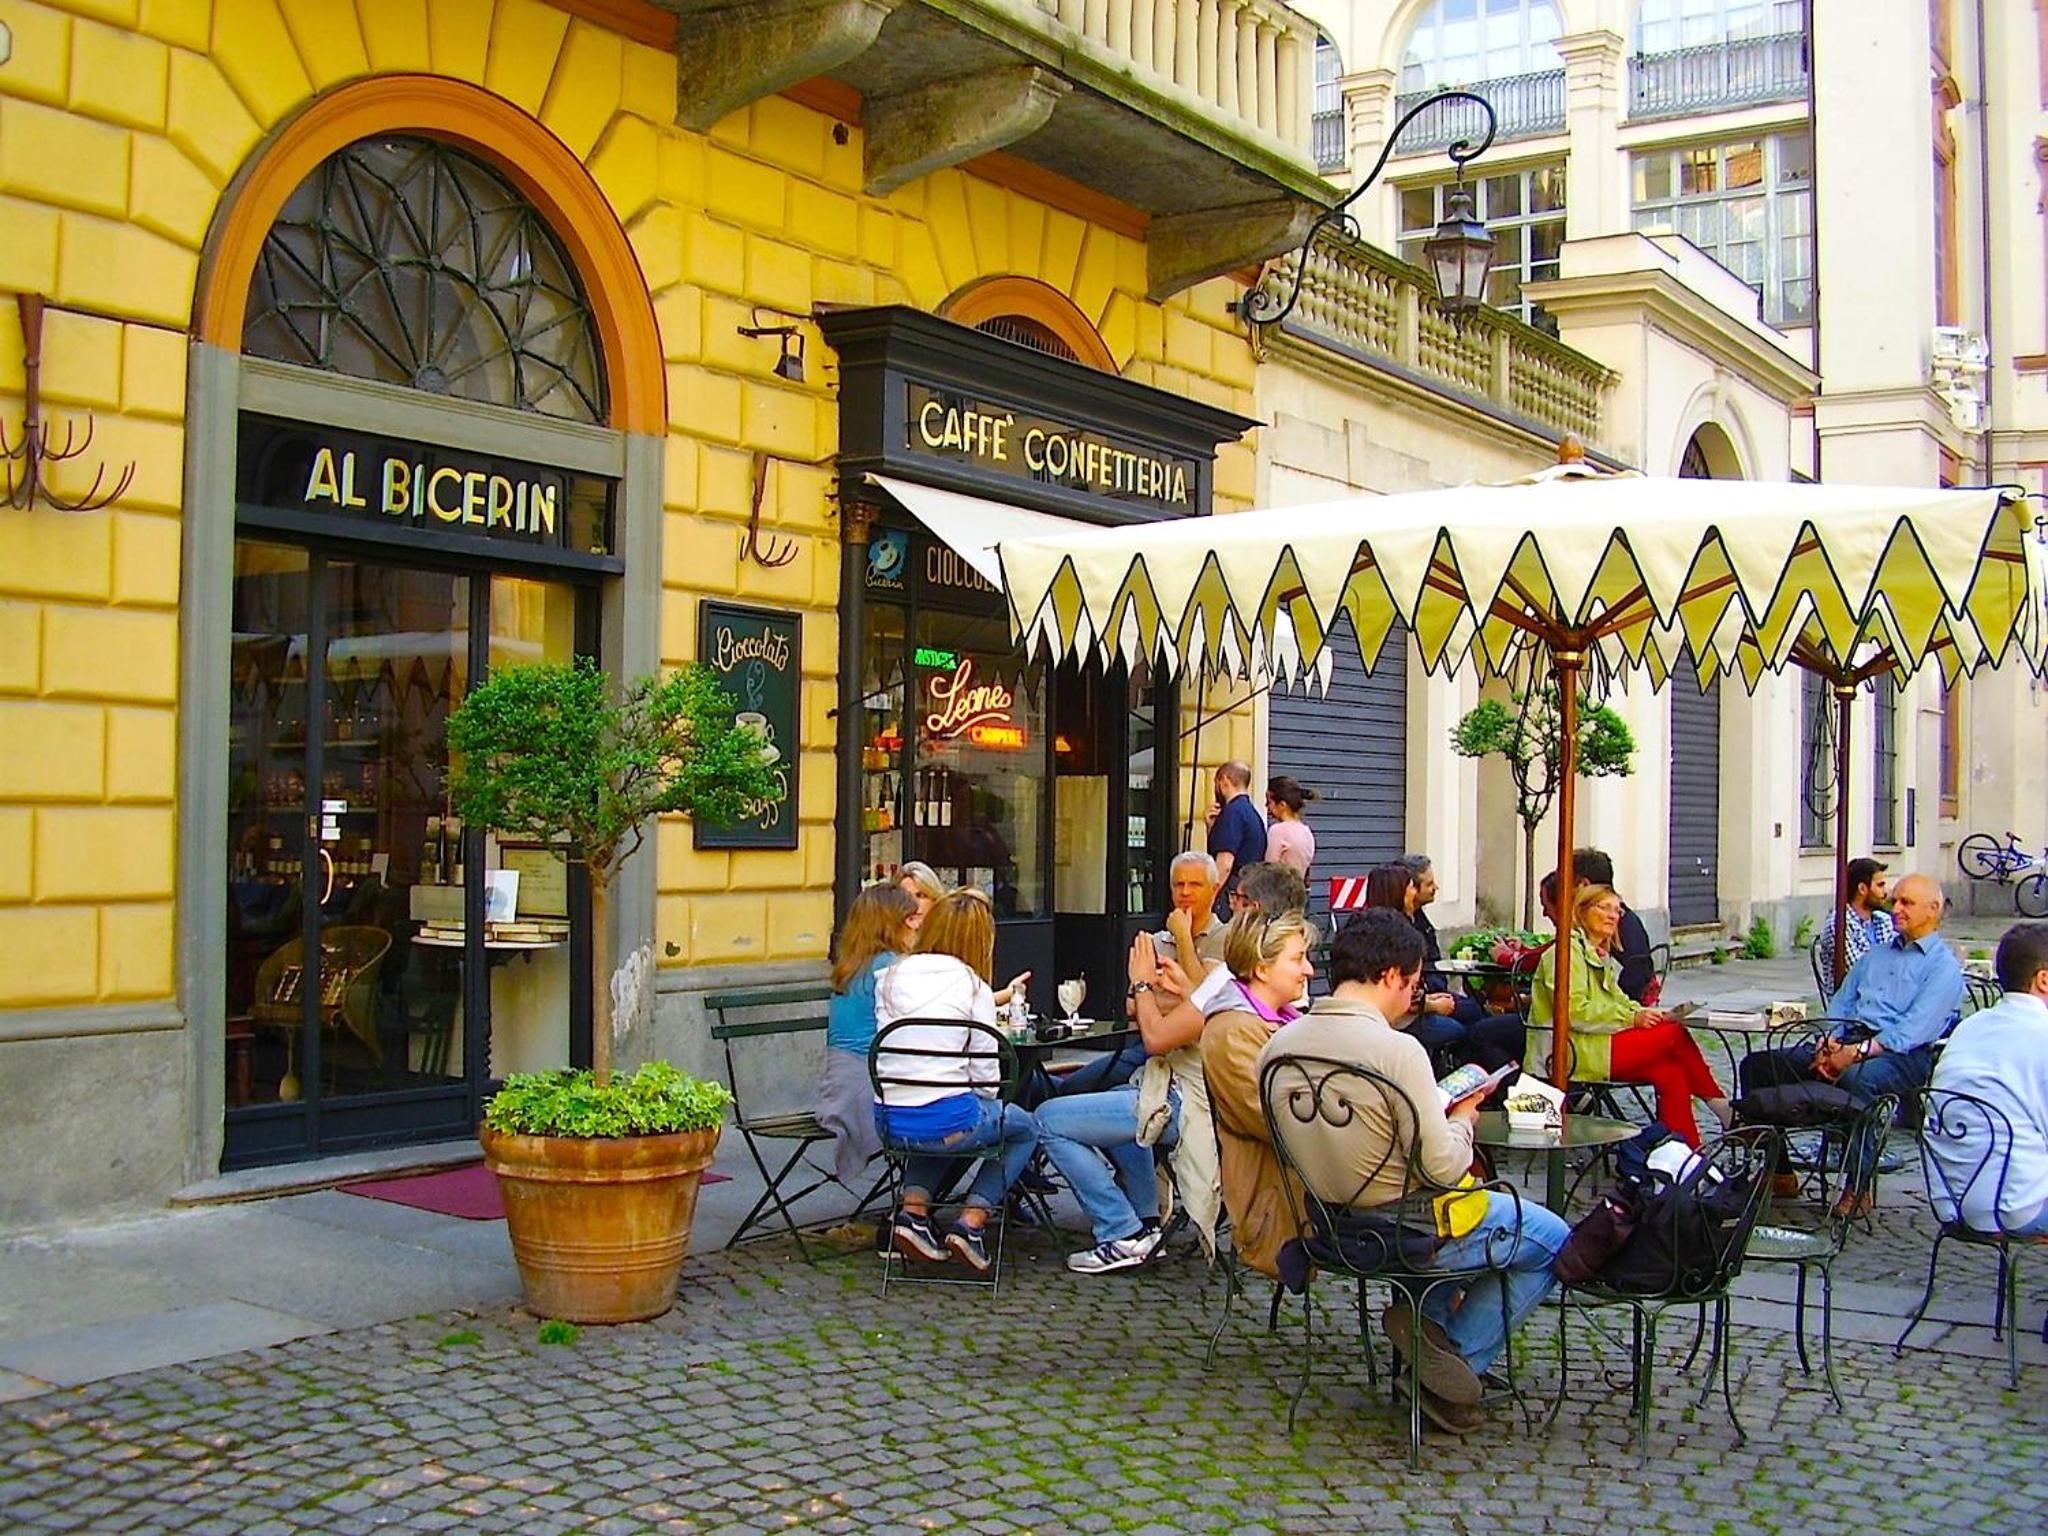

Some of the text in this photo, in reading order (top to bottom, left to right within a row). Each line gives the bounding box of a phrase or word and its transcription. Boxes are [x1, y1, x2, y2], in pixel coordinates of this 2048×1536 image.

[305, 448, 556, 534] AL BICERIN
[1025, 430, 1187, 504] CONFETTERIA
[927, 659, 1012, 731] Leone
